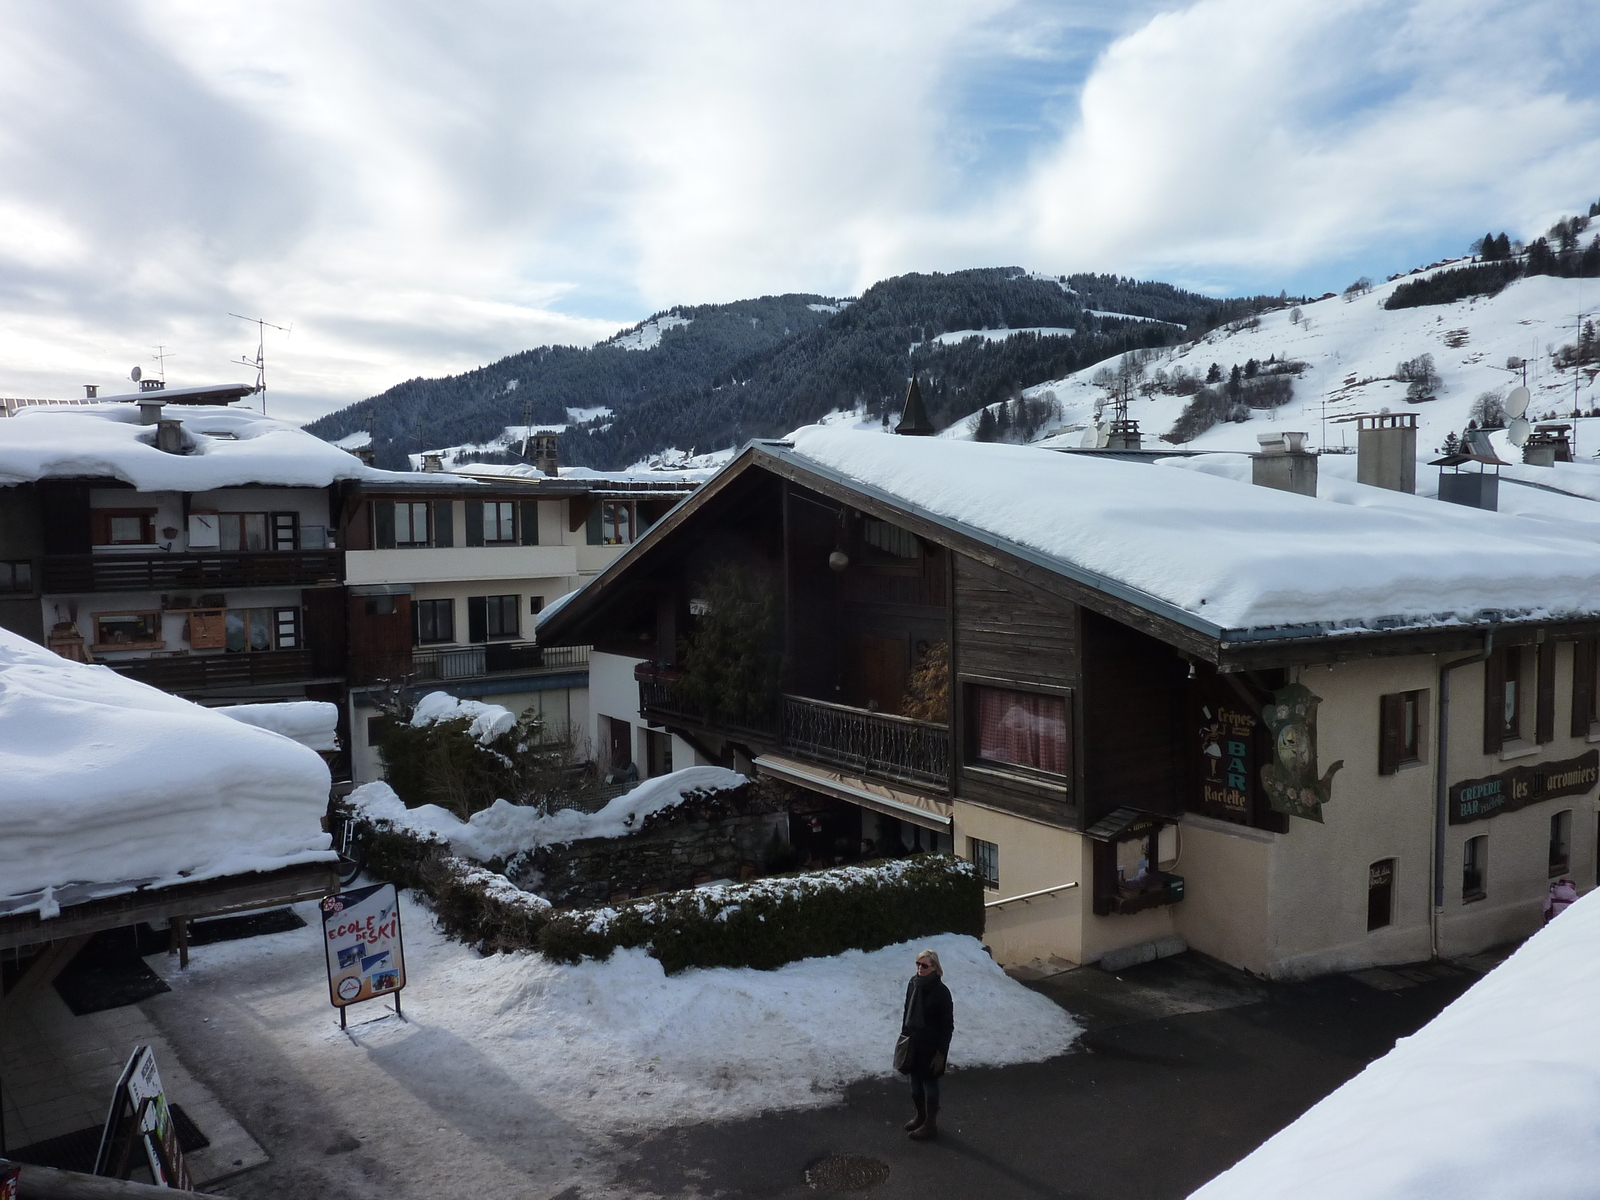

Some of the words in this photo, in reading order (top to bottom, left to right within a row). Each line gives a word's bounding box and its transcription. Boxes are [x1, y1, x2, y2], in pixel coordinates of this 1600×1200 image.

[1227, 740, 1248, 792] BAR
[1204, 784, 1246, 807] Raclette
[1512, 777, 1528, 800] les
[1460, 799, 1479, 817] BAR
[327, 915, 375, 940] ECOLE
[355, 931, 367, 942] DE
